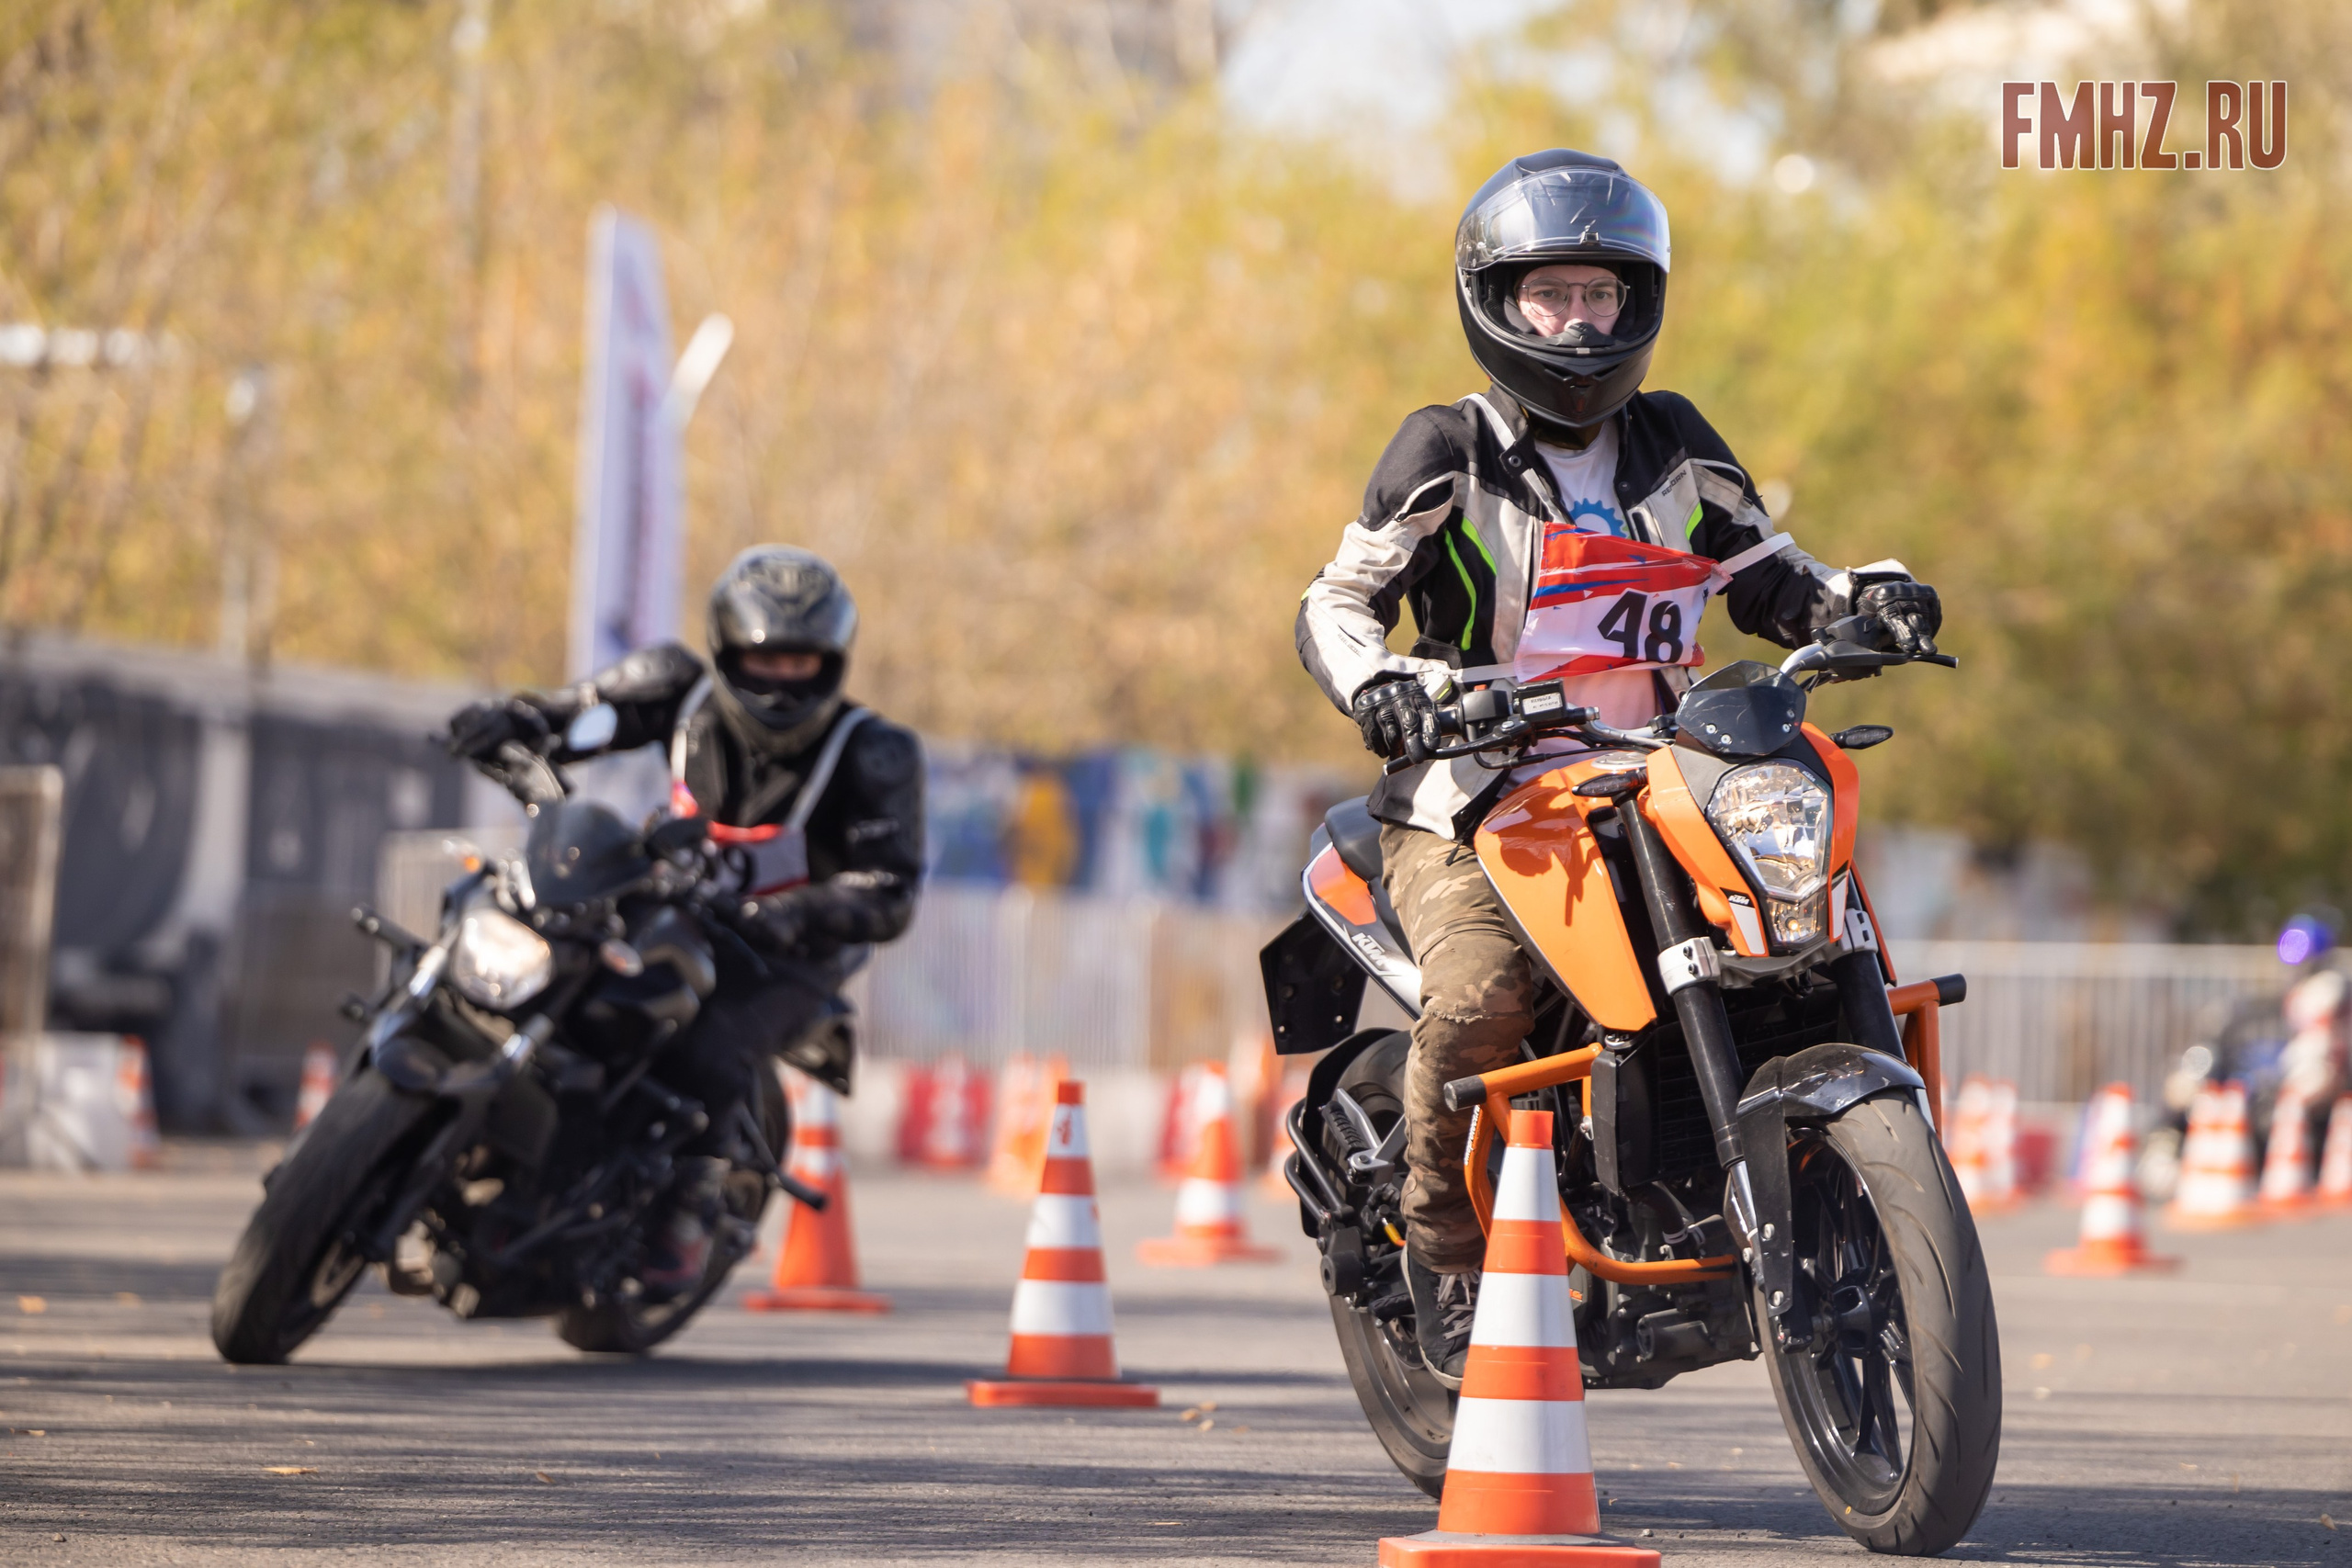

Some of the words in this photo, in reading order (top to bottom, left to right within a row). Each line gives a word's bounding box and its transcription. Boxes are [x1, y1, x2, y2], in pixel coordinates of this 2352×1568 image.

[1661, 469, 1687, 497] REORN
[1597, 590, 1684, 664] 48
[1728, 894, 1749, 906] KTM
[1351, 931, 1388, 967] KTM
